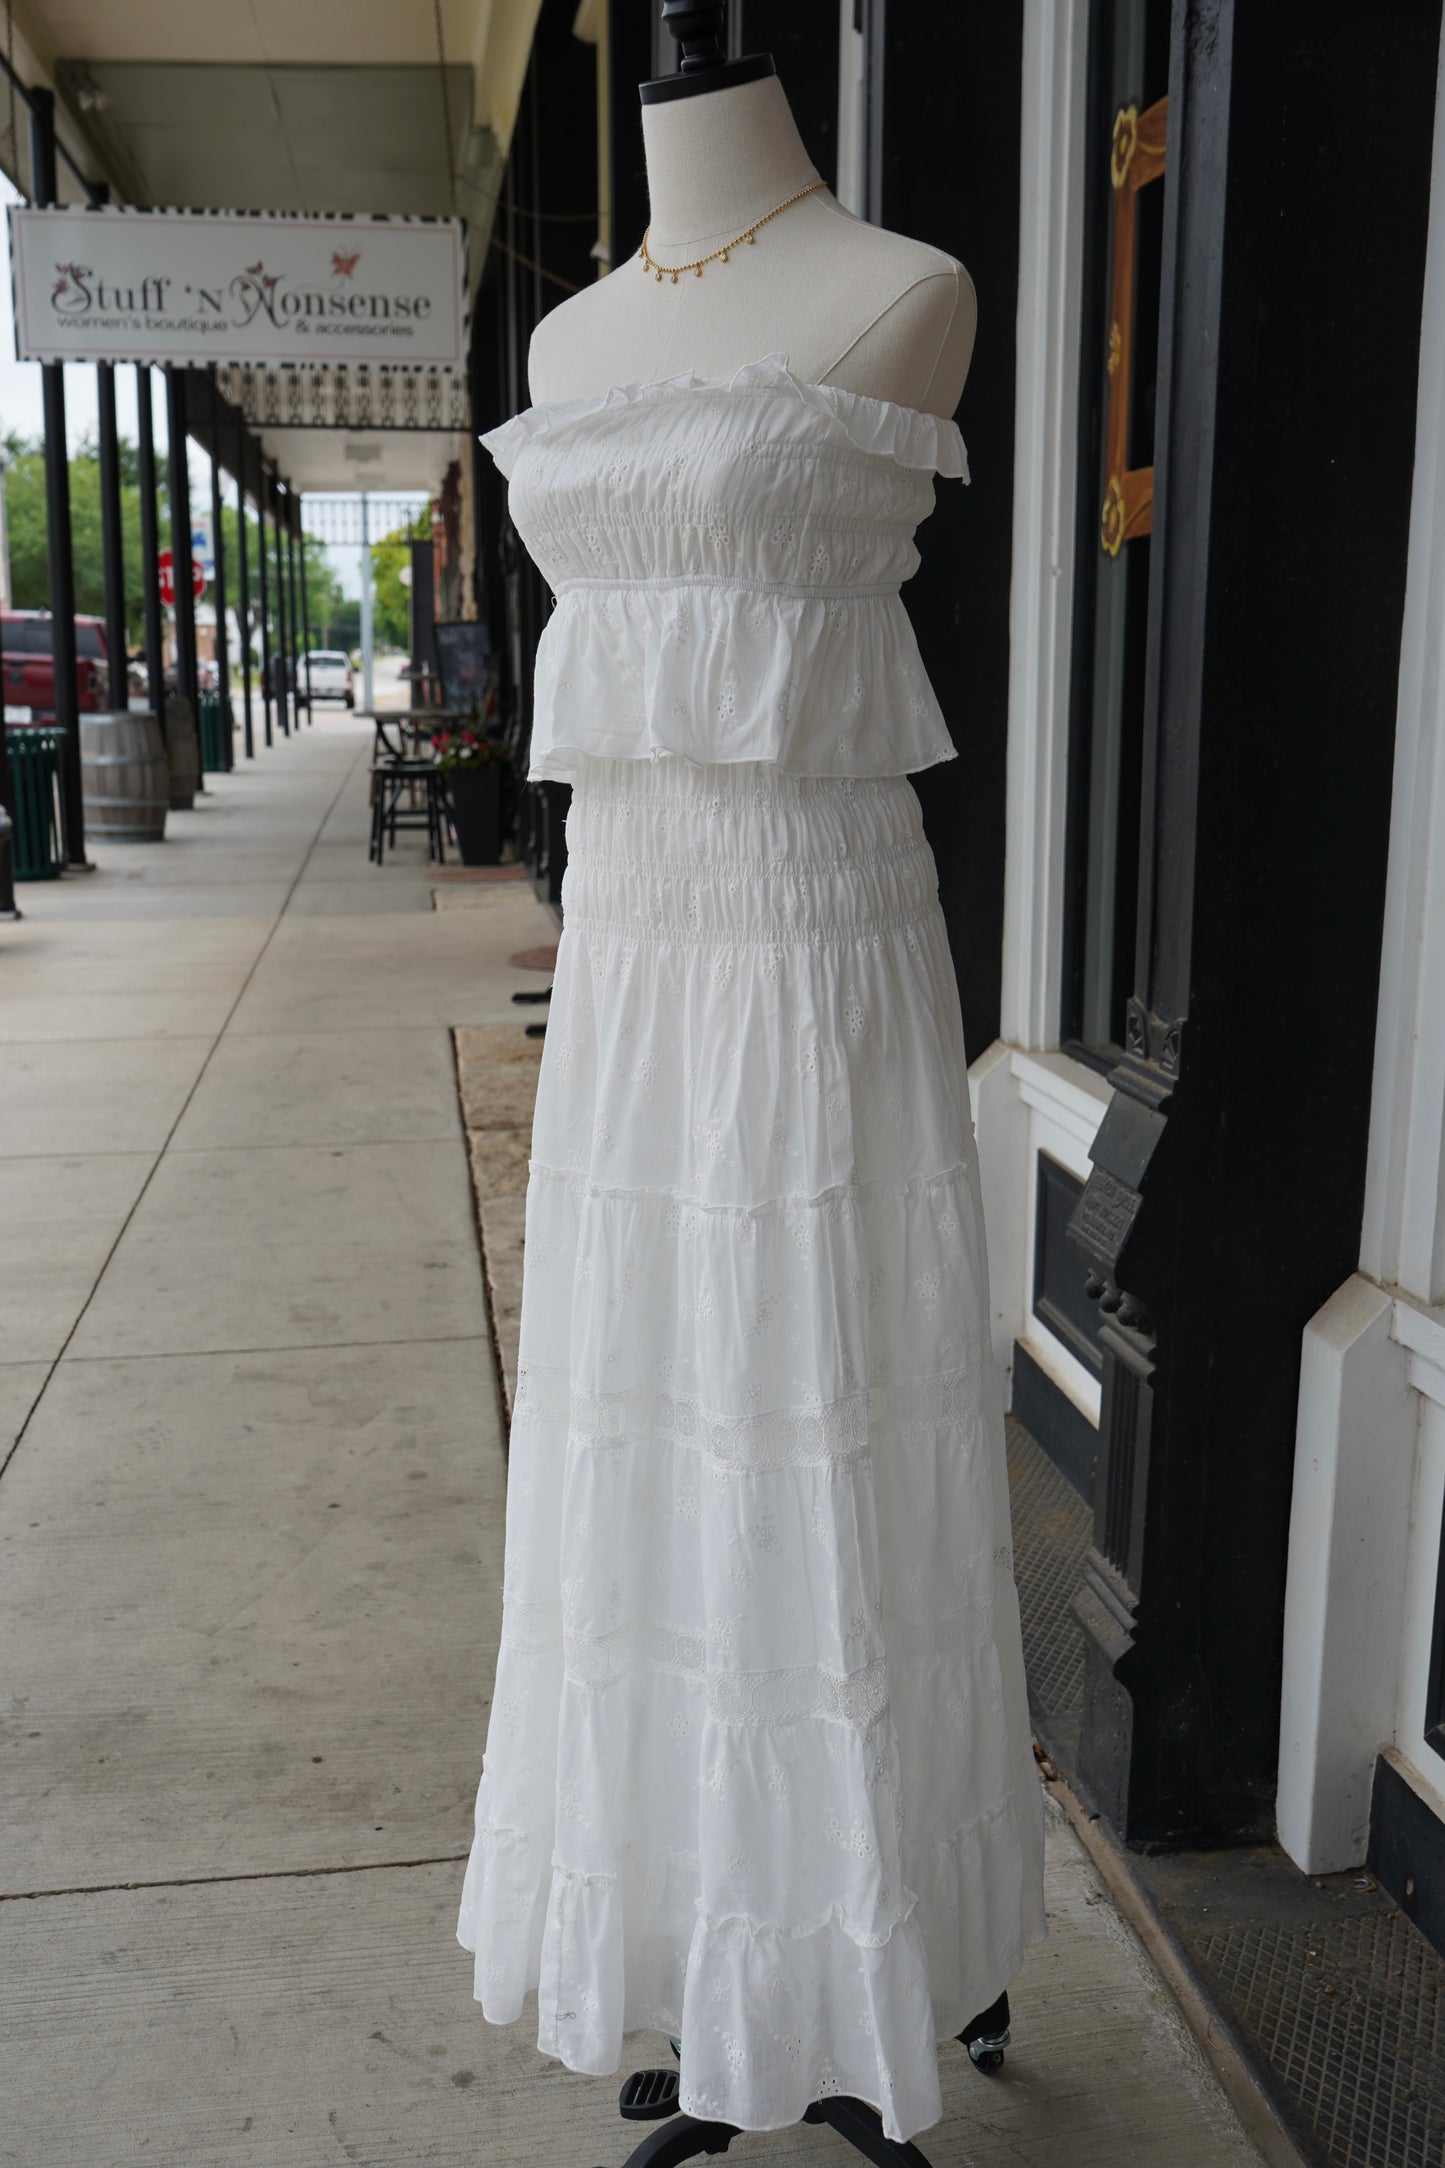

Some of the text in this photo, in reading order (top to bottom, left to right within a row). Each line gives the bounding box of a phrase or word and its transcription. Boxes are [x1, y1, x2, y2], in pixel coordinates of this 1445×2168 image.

[51, 263, 171, 315] Stuff
[229, 275, 431, 328] Nonsense
[57, 316, 414, 337] women's boutique & accessories
